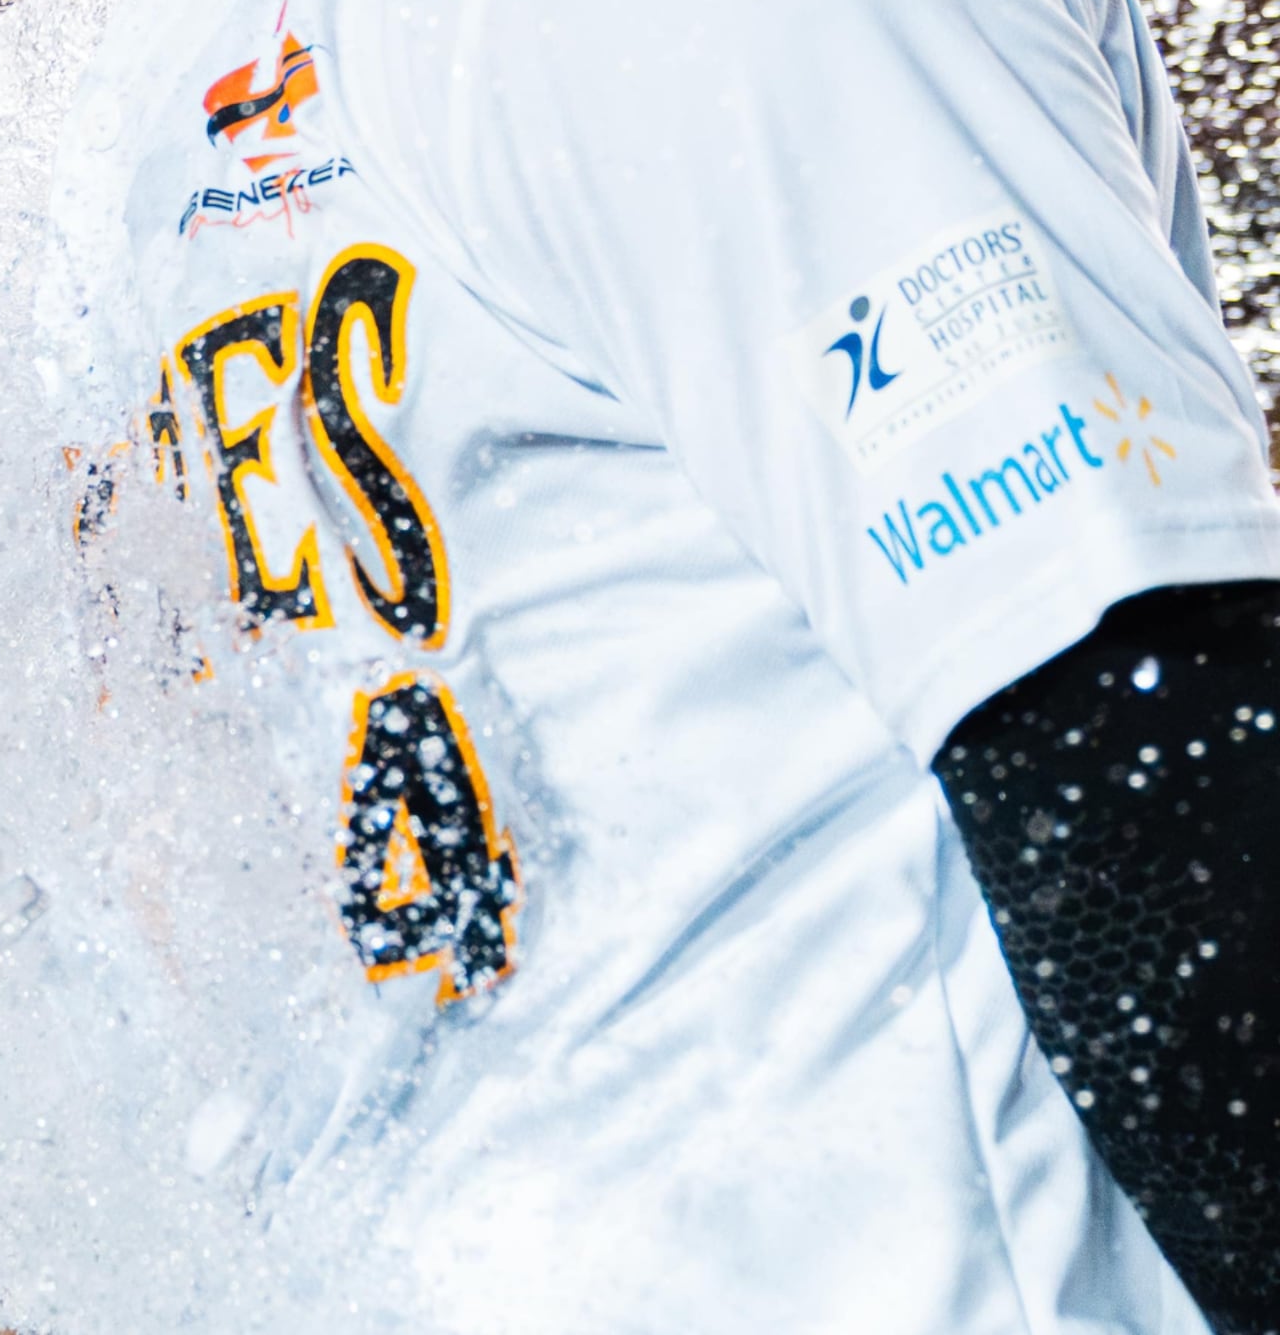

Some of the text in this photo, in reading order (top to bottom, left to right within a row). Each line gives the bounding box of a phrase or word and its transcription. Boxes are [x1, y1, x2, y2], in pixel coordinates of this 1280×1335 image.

[928, 279, 1049, 353] HOSPITAL
[866, 402, 1104, 585] Walmart
[336, 669, 524, 1008] 4
